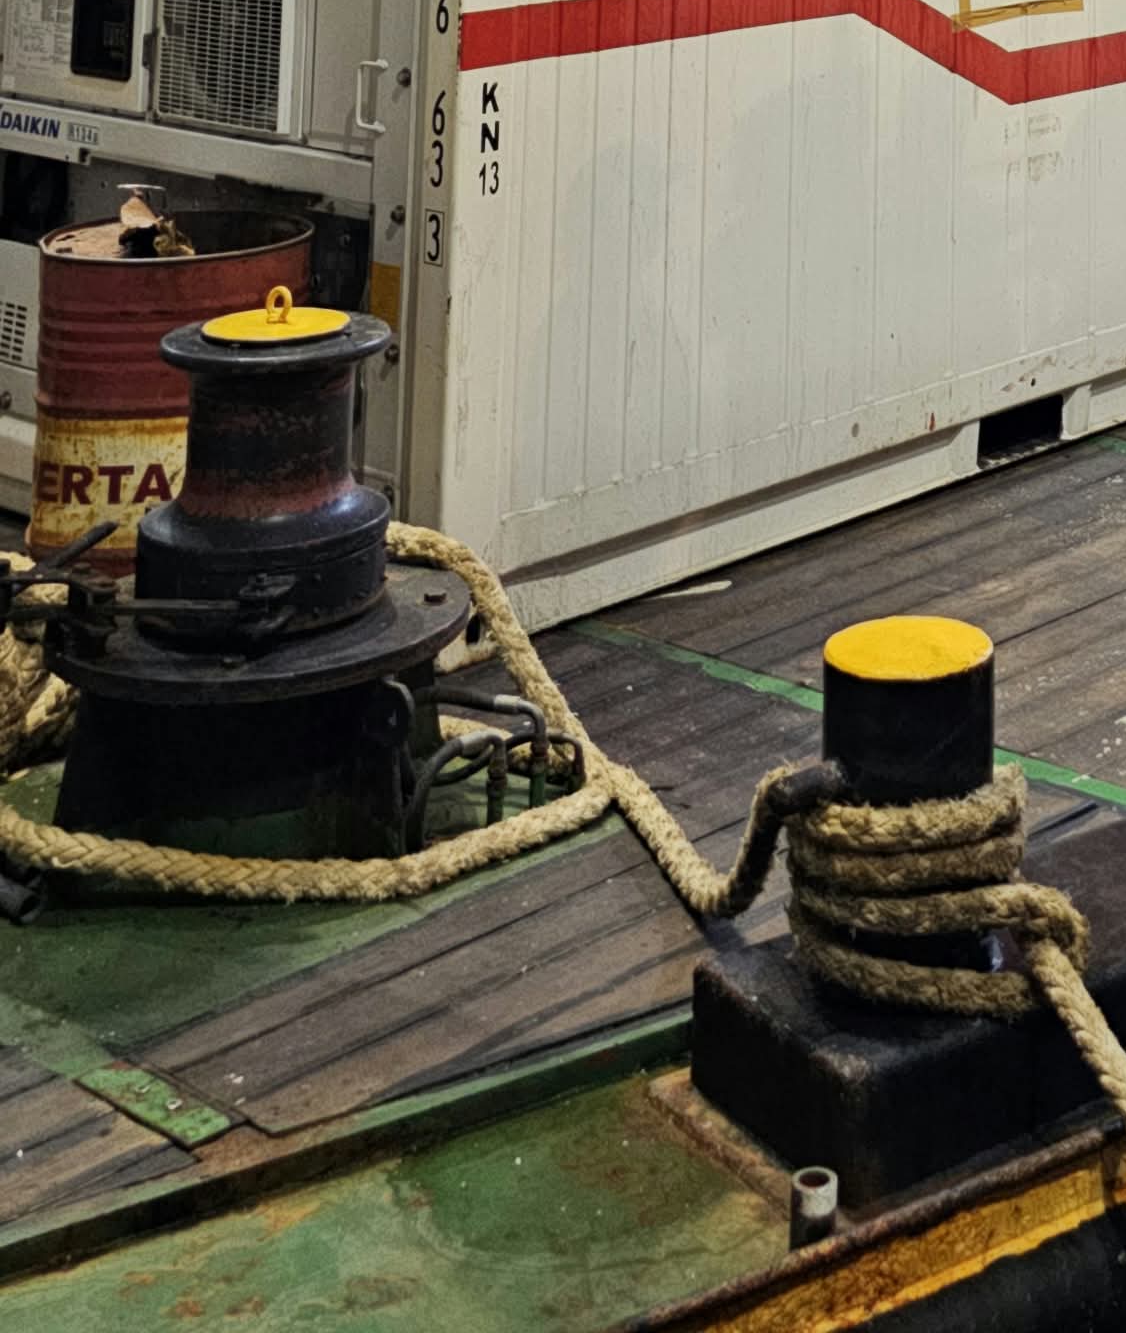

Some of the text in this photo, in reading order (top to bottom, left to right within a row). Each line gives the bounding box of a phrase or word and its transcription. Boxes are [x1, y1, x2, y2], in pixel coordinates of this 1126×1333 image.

[0, 111, 61, 139] DAIKIN
[478, 160, 500, 196] 13
[427, 213, 441, 262] 3
